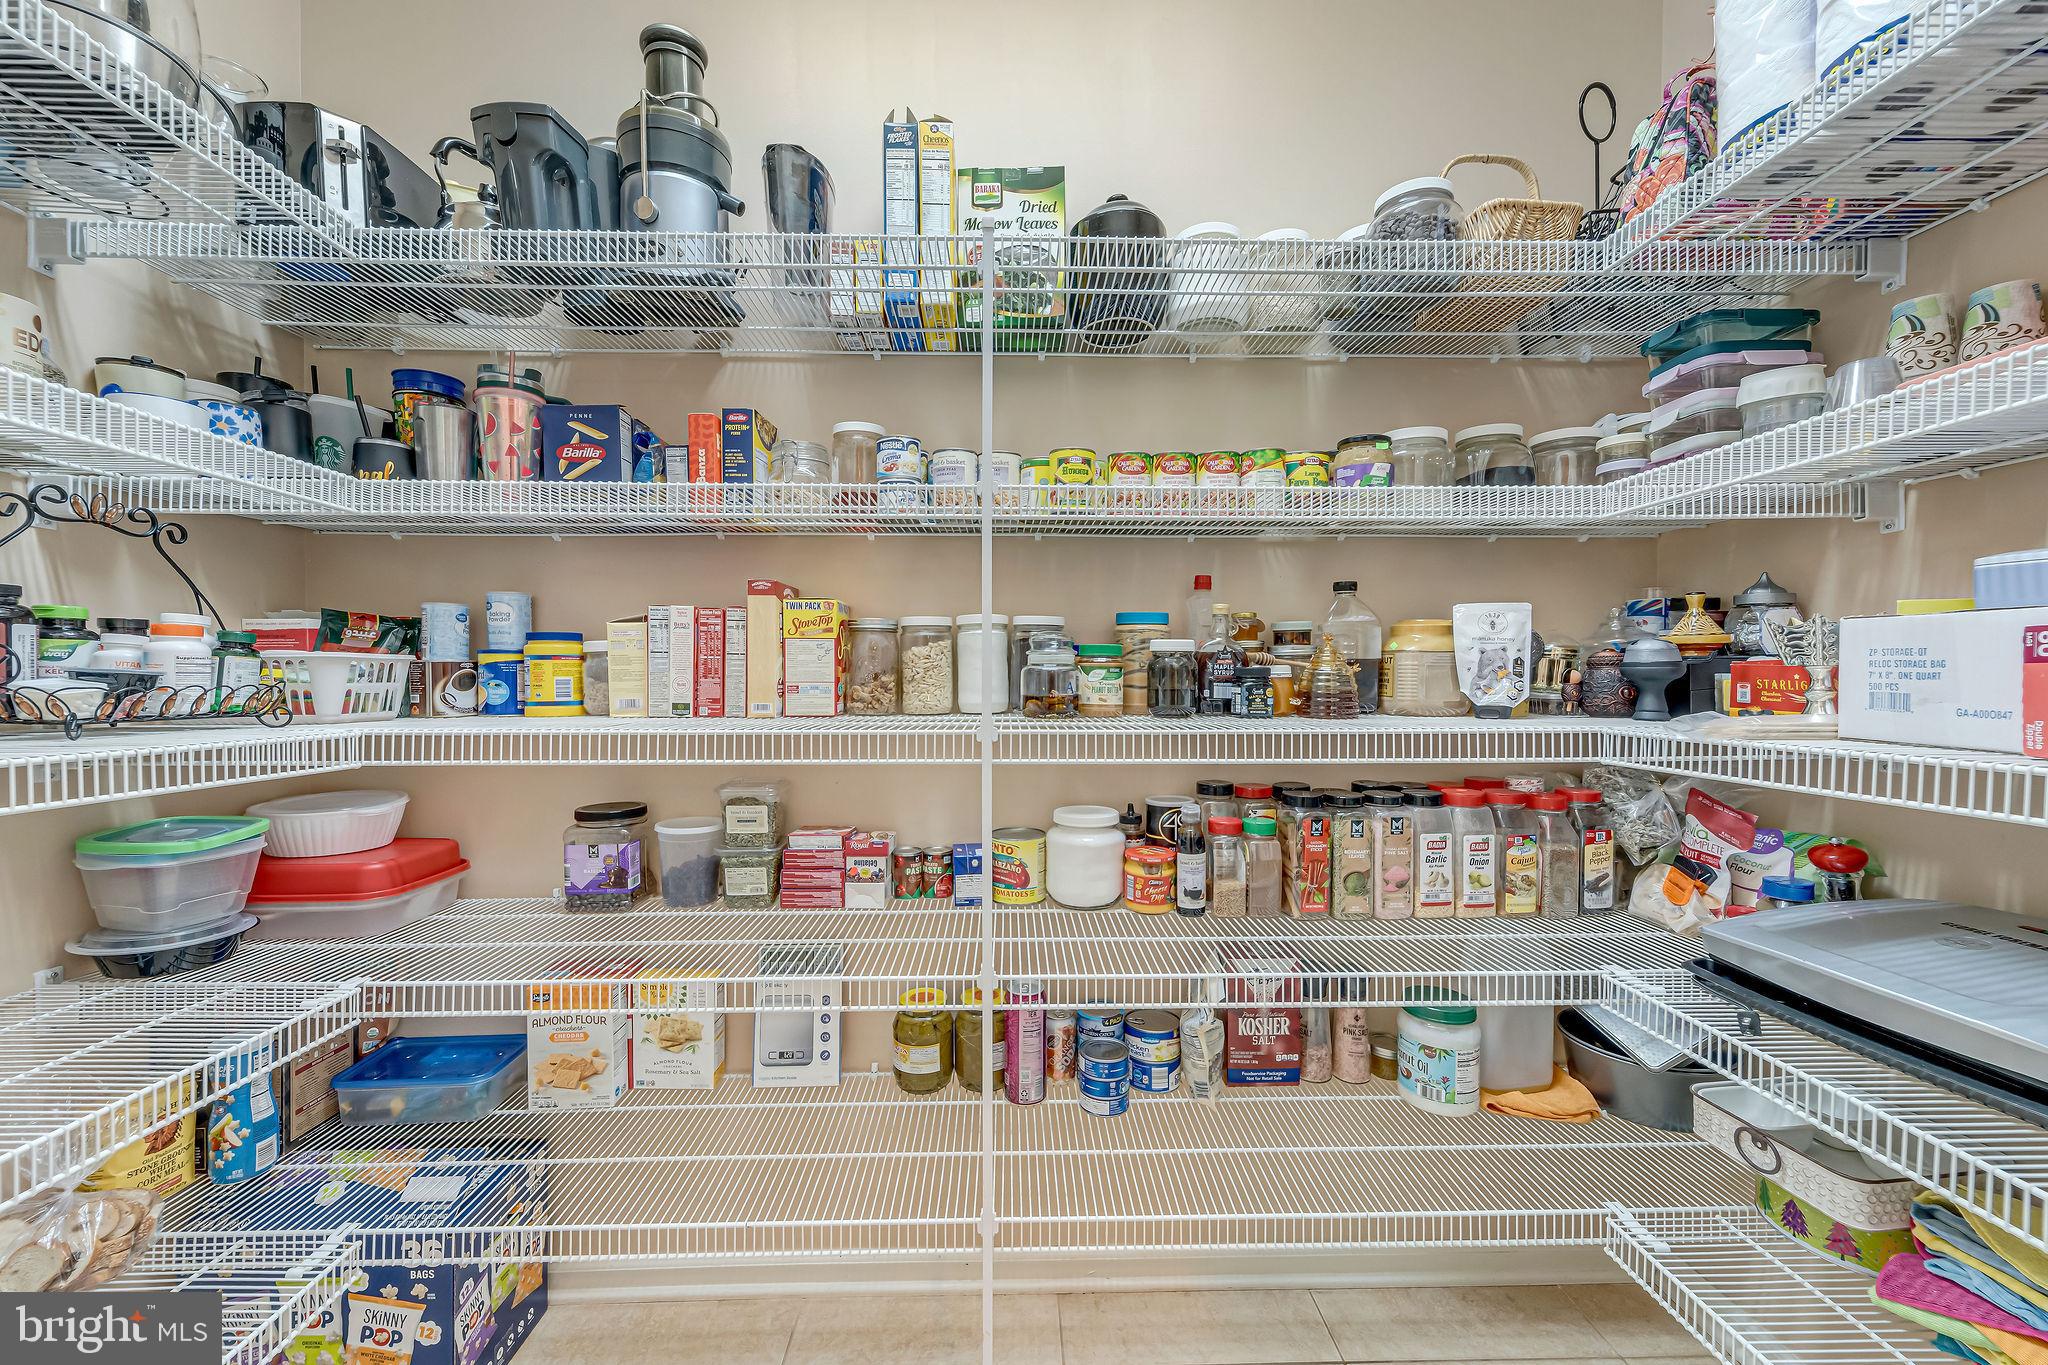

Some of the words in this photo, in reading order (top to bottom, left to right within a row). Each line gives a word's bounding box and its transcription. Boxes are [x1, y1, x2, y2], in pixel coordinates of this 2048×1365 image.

[975, 185, 1000, 193] BARAKA
[1019, 200, 1058, 213] Dried
[1016, 217, 1058, 232] Leaves
[562, 448, 600, 458] Barilla
[1869, 660, 1892, 668] RELOC
[1894, 660, 1927, 669] STORAGE
[1931, 660, 1946, 669] BAG
[1898, 672, 1913, 680] ONE
[1916, 672, 1942, 680] QUART
[1756, 679, 1808, 691] STARLIG
[1885, 683, 1900, 691] PCS
[2026, 723, 2035, 749] Zipper
[851, 840, 870, 850] Royal
[1428, 842, 1446, 850] BADIA
[854, 859, 878, 867] Gelatine
[1425, 855, 1448, 864] Garlic
[1469, 857, 1490, 866] Onion
[1511, 857, 1535, 867] Cajun
[1589, 856, 1611, 866] Pepper
[1733, 854, 1773, 871] Coconut
[1729, 862, 1755, 876] Flour
[1144, 886, 1168, 896] Cheese
[1150, 894, 1165, 903] Dip
[532, 1015, 573, 1028] ALMOND
[575, 1015, 607, 1026] FLOUR
[1238, 1018, 1290, 1036] KOSHER
[1343, 1027, 1357, 1036] PINK
[1252, 1036, 1275, 1045] SALT
[1417, 1060, 1429, 1075] Oil
[126, 1160, 158, 1179] STONE
[149, 1159, 177, 1177] WHITE
[137, 1175, 162, 1188] CORN
[163, 1160, 187, 1180] MEAL
[402, 1240, 443, 1267] 36
[410, 1270, 435, 1280] BAGS
[360, 1325, 403, 1347] POP
[419, 1326, 435, 1339] 12
